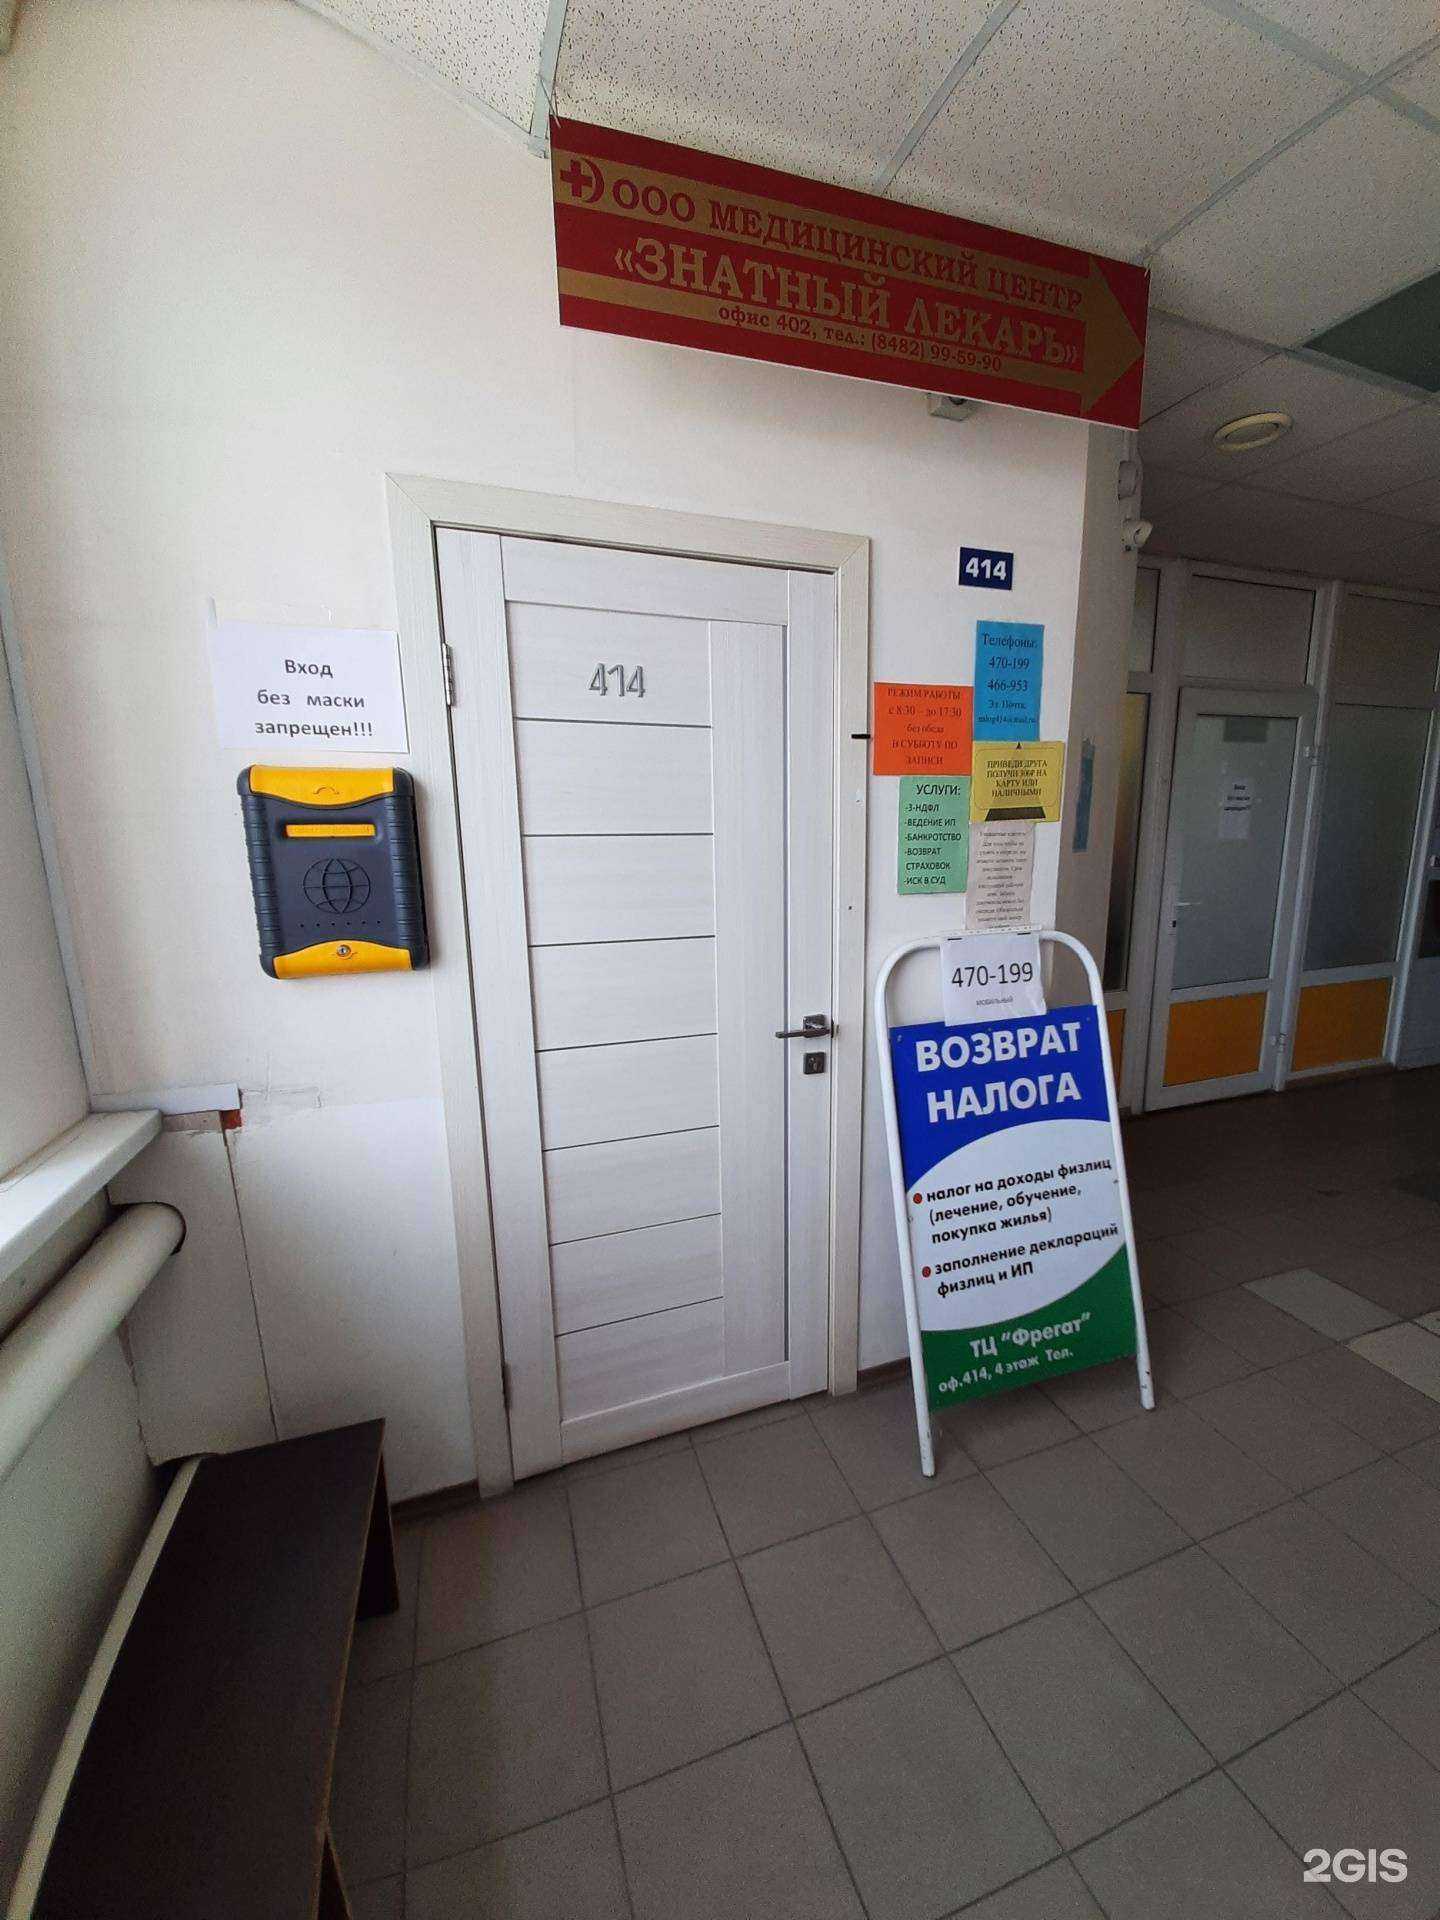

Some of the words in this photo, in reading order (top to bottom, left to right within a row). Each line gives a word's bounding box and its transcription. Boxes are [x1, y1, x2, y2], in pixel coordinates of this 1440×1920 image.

[613, 179, 695, 222] ООО
[709, 200, 978, 289] МЕДИЦИНСКИЙ
[986, 267, 1082, 313] ЦЕНТР
[614, 237, 890, 329] «ЗНАТНЫЙ
[904, 297, 1078, 365] ЛЕКАРЬ»
[718, 307, 770, 327] офис
[776, 313, 817, 340] 402,
[823, 325, 865, 346] тел.:
[872, 332, 924, 359] (8482)
[930, 345, 1001, 372] 99-59-90
[965, 557, 1007, 580] 414
[285, 659, 333, 678] Вход
[988, 656, 1030, 670] 470-199
[587, 662, 646, 698] 414
[987, 679, 1028, 692] 466-953
[257, 689, 291, 705] без
[307, 695, 365, 708] маски
[887, 688, 922, 698] РЕЖИМ
[924, 690, 960, 700] РАБОТЫ
[255, 722, 373, 738] запрещен!!!
[901, 740, 942, 750] СУББОТУ
[905, 755, 943, 765] ЗАПИСИ
[987, 760, 1023, 769] ПРИВЕДИ
[1023, 759, 1048, 768] ДРУГА
[916, 784, 961, 796] УСЛУГИ:
[995, 779, 1020, 787] КАРТУ
[944, 818, 956, 827] ИП
[905, 861, 951, 871] СТРАХОВОК
[924, 876, 930, 885] В
[931, 876, 947, 885] СУД
[951, 962, 1033, 988] 470-199
[916, 1022, 1081, 1073] ВОЗВРАТ
[927, 1072, 1082, 1123] НАЛОГА
[927, 1184, 970, 1202] налог
[975, 1180, 994, 1195] на
[997, 1169, 1055, 1190] доходы
[1057, 1158, 1112, 1179] физлиц
[929, 1200, 1003, 1225] (лечение,
[1007, 1185, 1082, 1208] обучение,
[932, 1220, 997, 1244] покупка
[1001, 1207, 1052, 1229] жилья)
[935, 1244, 1026, 1275] заполнение
[1030, 1222, 1118, 1255] деклараций
[937, 1273, 996, 1298] физлиц
[998, 1270, 1008, 1281] и
[1011, 1261, 1034, 1278] ИП
[969, 1336, 998, 1358] ТЦ
[938, 1366, 992, 1392] оф.414,
[995, 1362, 1004, 1375] 4
[1005, 1355, 1040, 1374] этаж
[1045, 1348, 1074, 1362] Тел.
